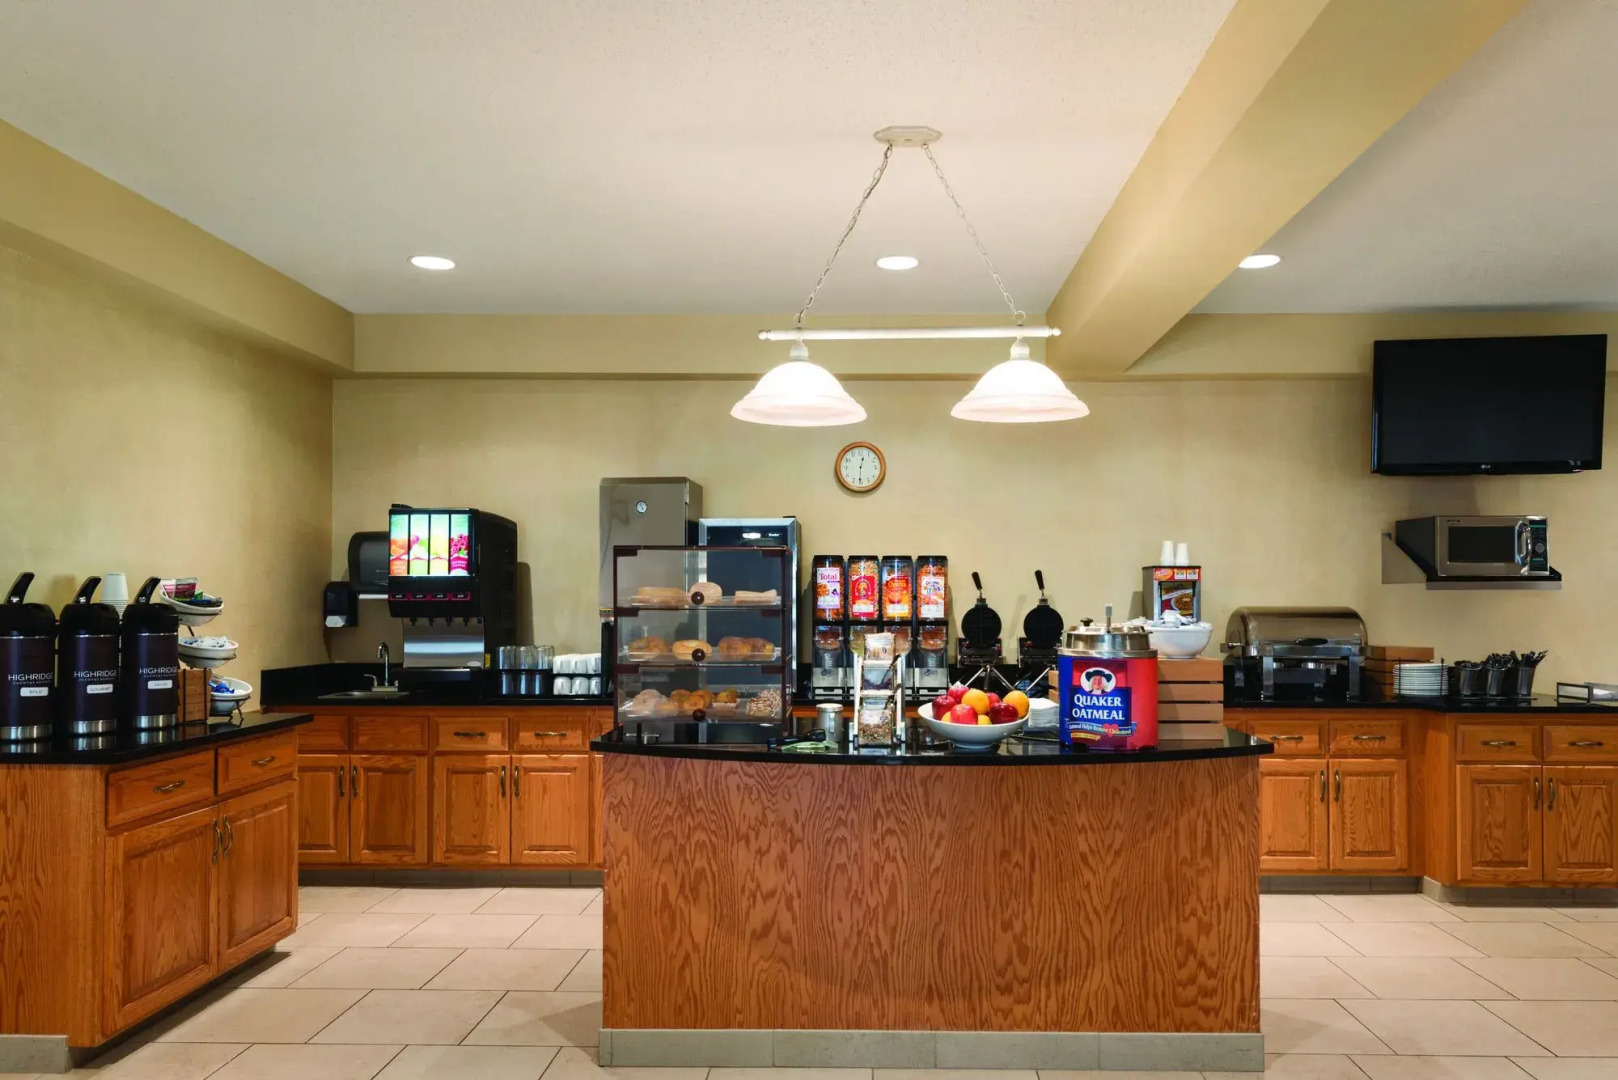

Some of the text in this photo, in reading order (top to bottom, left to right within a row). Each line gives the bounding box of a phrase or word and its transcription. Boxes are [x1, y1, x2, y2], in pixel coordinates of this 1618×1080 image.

[74, 670, 117, 678] HIGHRIDGE
[139, 666, 177, 674] HIGHRIDGE
[8, 672, 53, 681] HIGHRIDGE
[1074, 694, 1122, 707] QUAKER
[1072, 708, 1125, 720] OATMEAL
